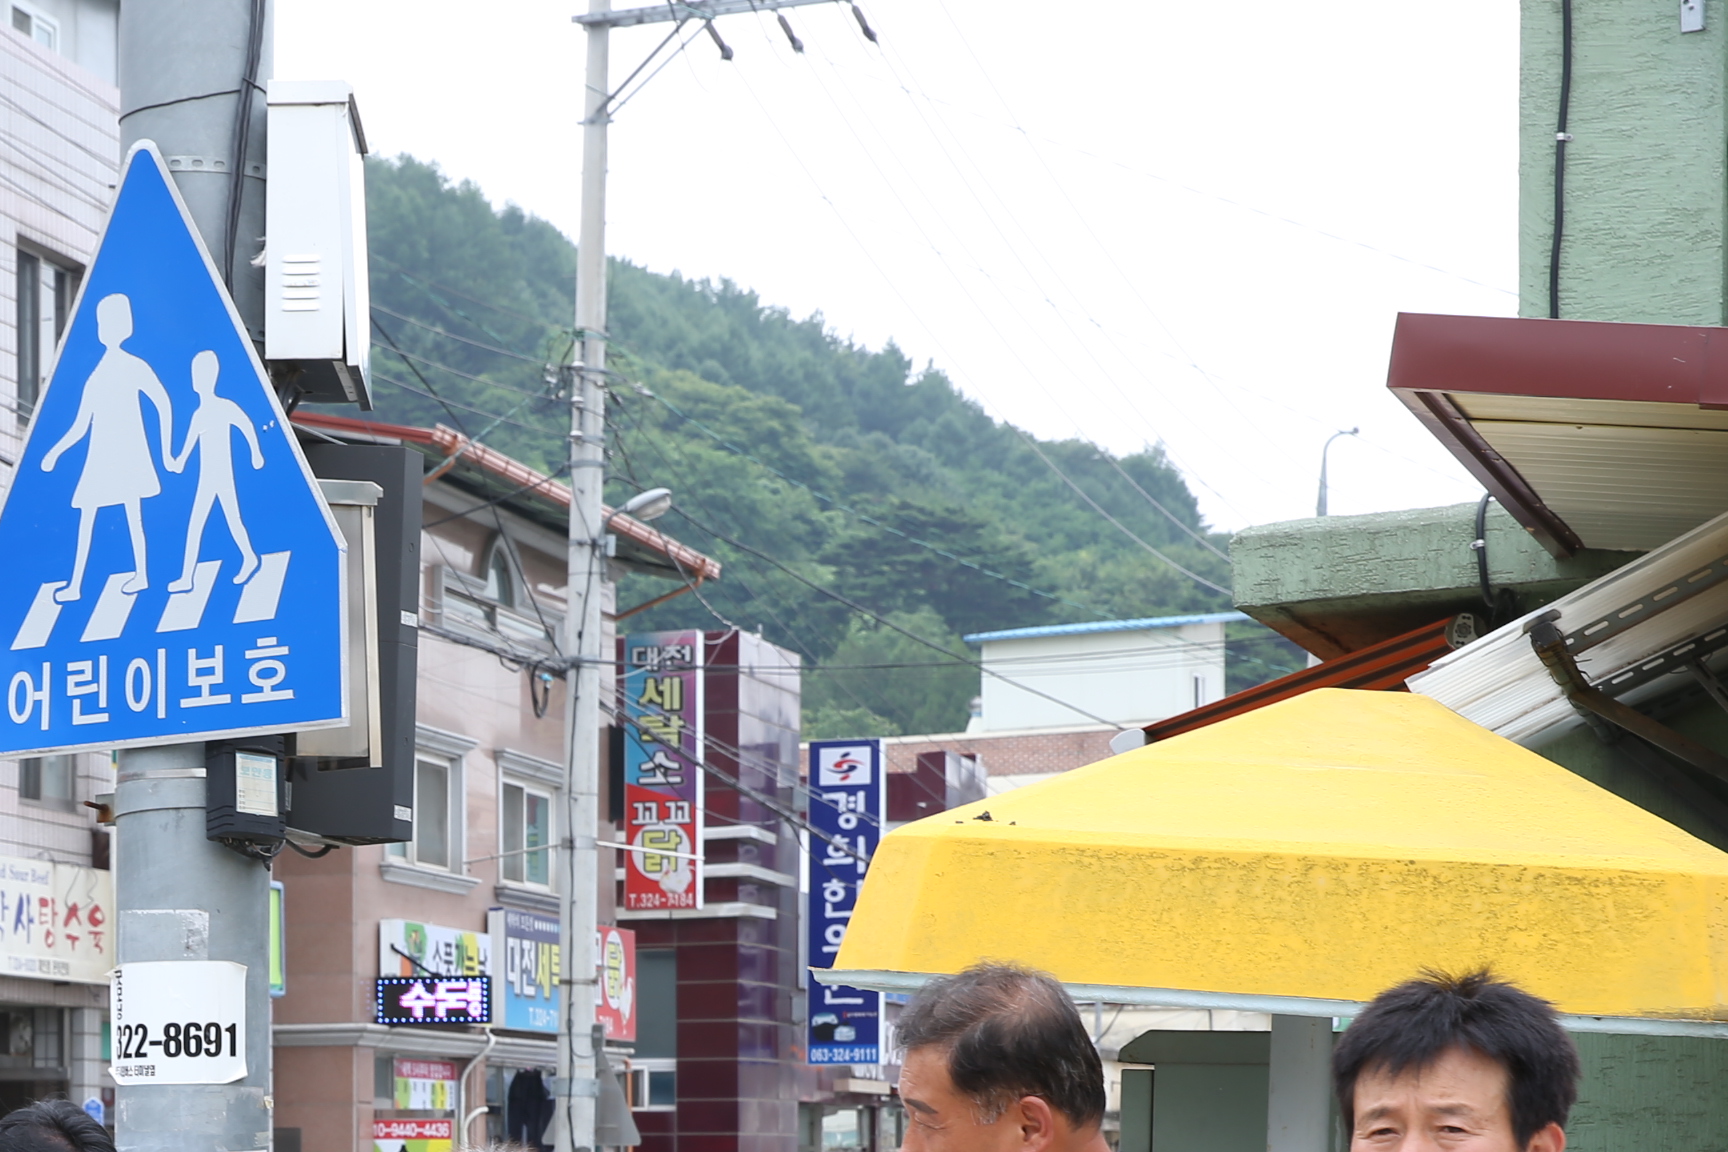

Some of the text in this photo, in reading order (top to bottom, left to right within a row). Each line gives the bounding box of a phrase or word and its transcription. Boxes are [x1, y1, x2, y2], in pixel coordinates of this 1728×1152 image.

[632, 645, 692, 671] 대전
[7, 637, 295, 731] 어린이보호
[638, 676, 684, 786] 세탁소
[642, 830, 682, 873] 닭
[822, 790, 866, 1005] 경희한의
[116, 1022, 237, 1060] 322-8691
[810, 1047, 877, 1062] 063-324-9111
